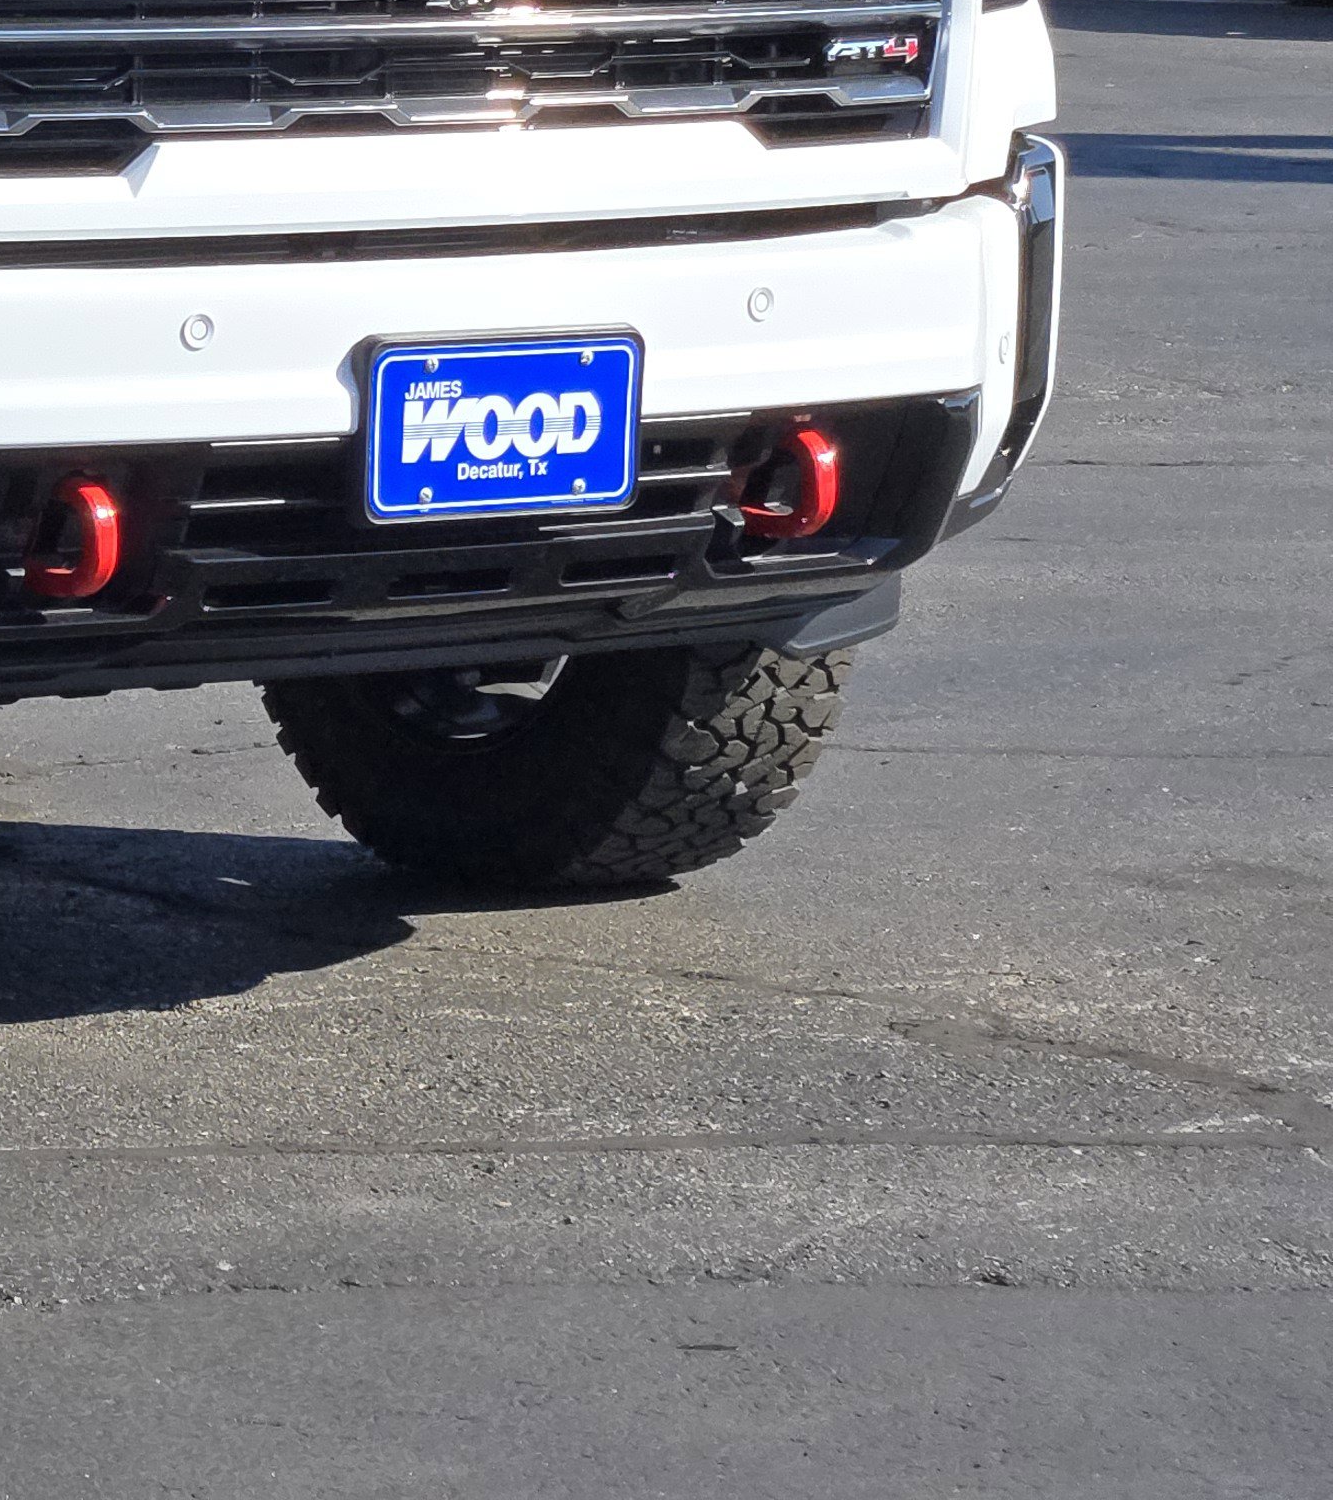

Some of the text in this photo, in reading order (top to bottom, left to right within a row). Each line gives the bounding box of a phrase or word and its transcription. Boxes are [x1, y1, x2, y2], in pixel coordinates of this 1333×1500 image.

[822, 37, 919, 65] AT4
[404, 380, 463, 400] JAMES
[401, 392, 602, 464] WOOD
[457, 458, 549, 481] Decatur, Tx
